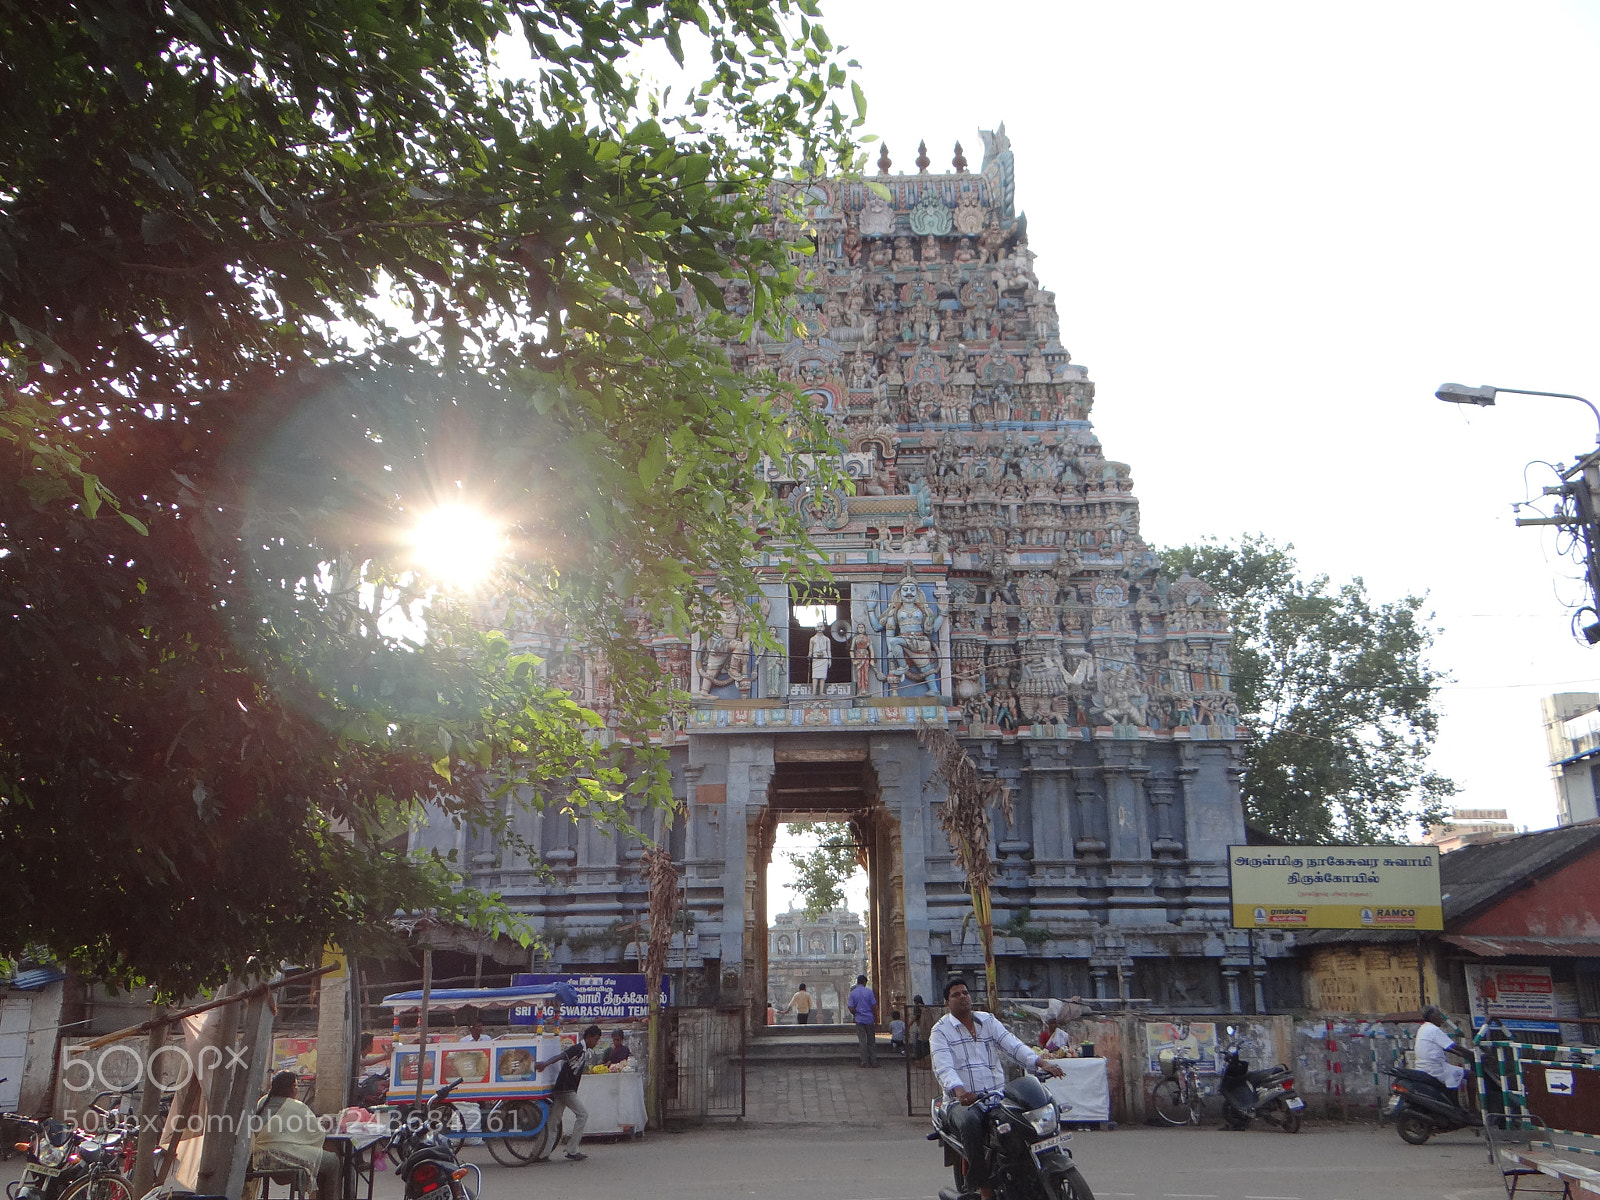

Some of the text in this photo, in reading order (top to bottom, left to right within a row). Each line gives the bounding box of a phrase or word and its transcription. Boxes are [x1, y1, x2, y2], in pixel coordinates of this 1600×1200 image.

[1234, 854, 1433, 869] அருள்மிகு நாகேசுவர சுவாமி
[1287, 871, 1380, 885] திருக்கோயில்
[1376, 909, 1416, 917] RAMCO
[515, 1006, 531, 1016] SRI
